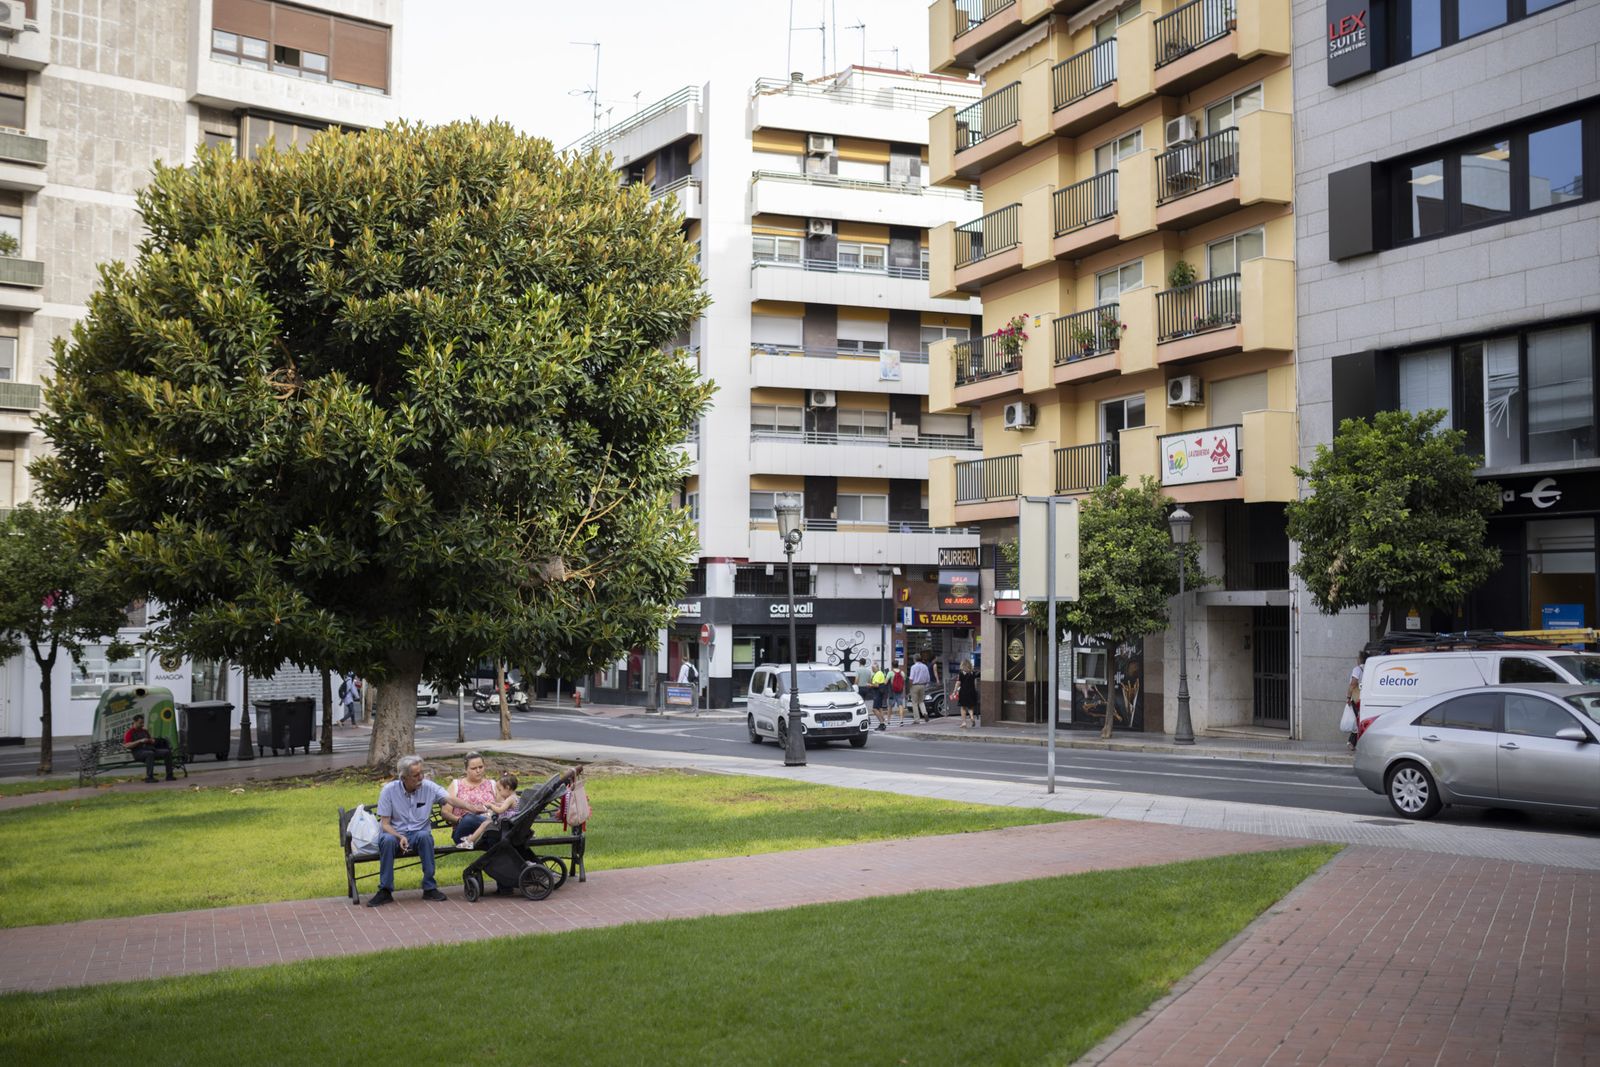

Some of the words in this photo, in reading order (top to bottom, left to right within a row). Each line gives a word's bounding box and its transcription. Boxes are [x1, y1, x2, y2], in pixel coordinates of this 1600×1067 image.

[1329, 10, 1366, 40] LEX
[1329, 28, 1366, 52] SUITE
[1329, 41, 1367, 59] CONSULTING
[1379, 675, 1419, 686] elecnor
